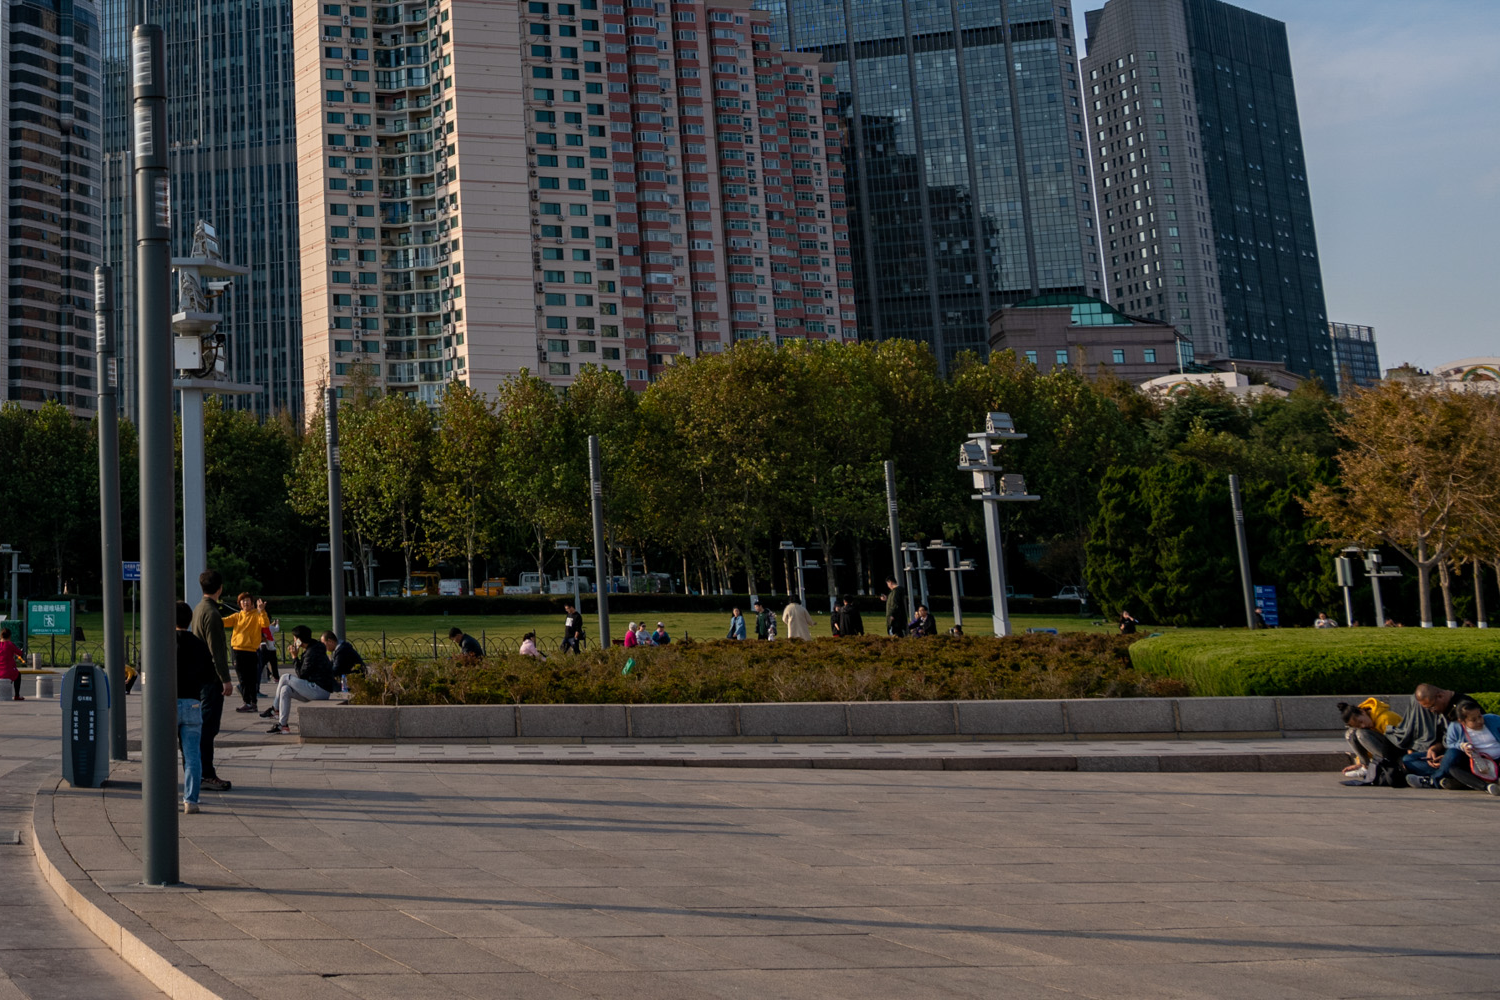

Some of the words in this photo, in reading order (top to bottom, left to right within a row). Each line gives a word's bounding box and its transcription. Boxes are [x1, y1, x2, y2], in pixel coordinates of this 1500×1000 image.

[32, 604, 66, 613] 应急避难场所
